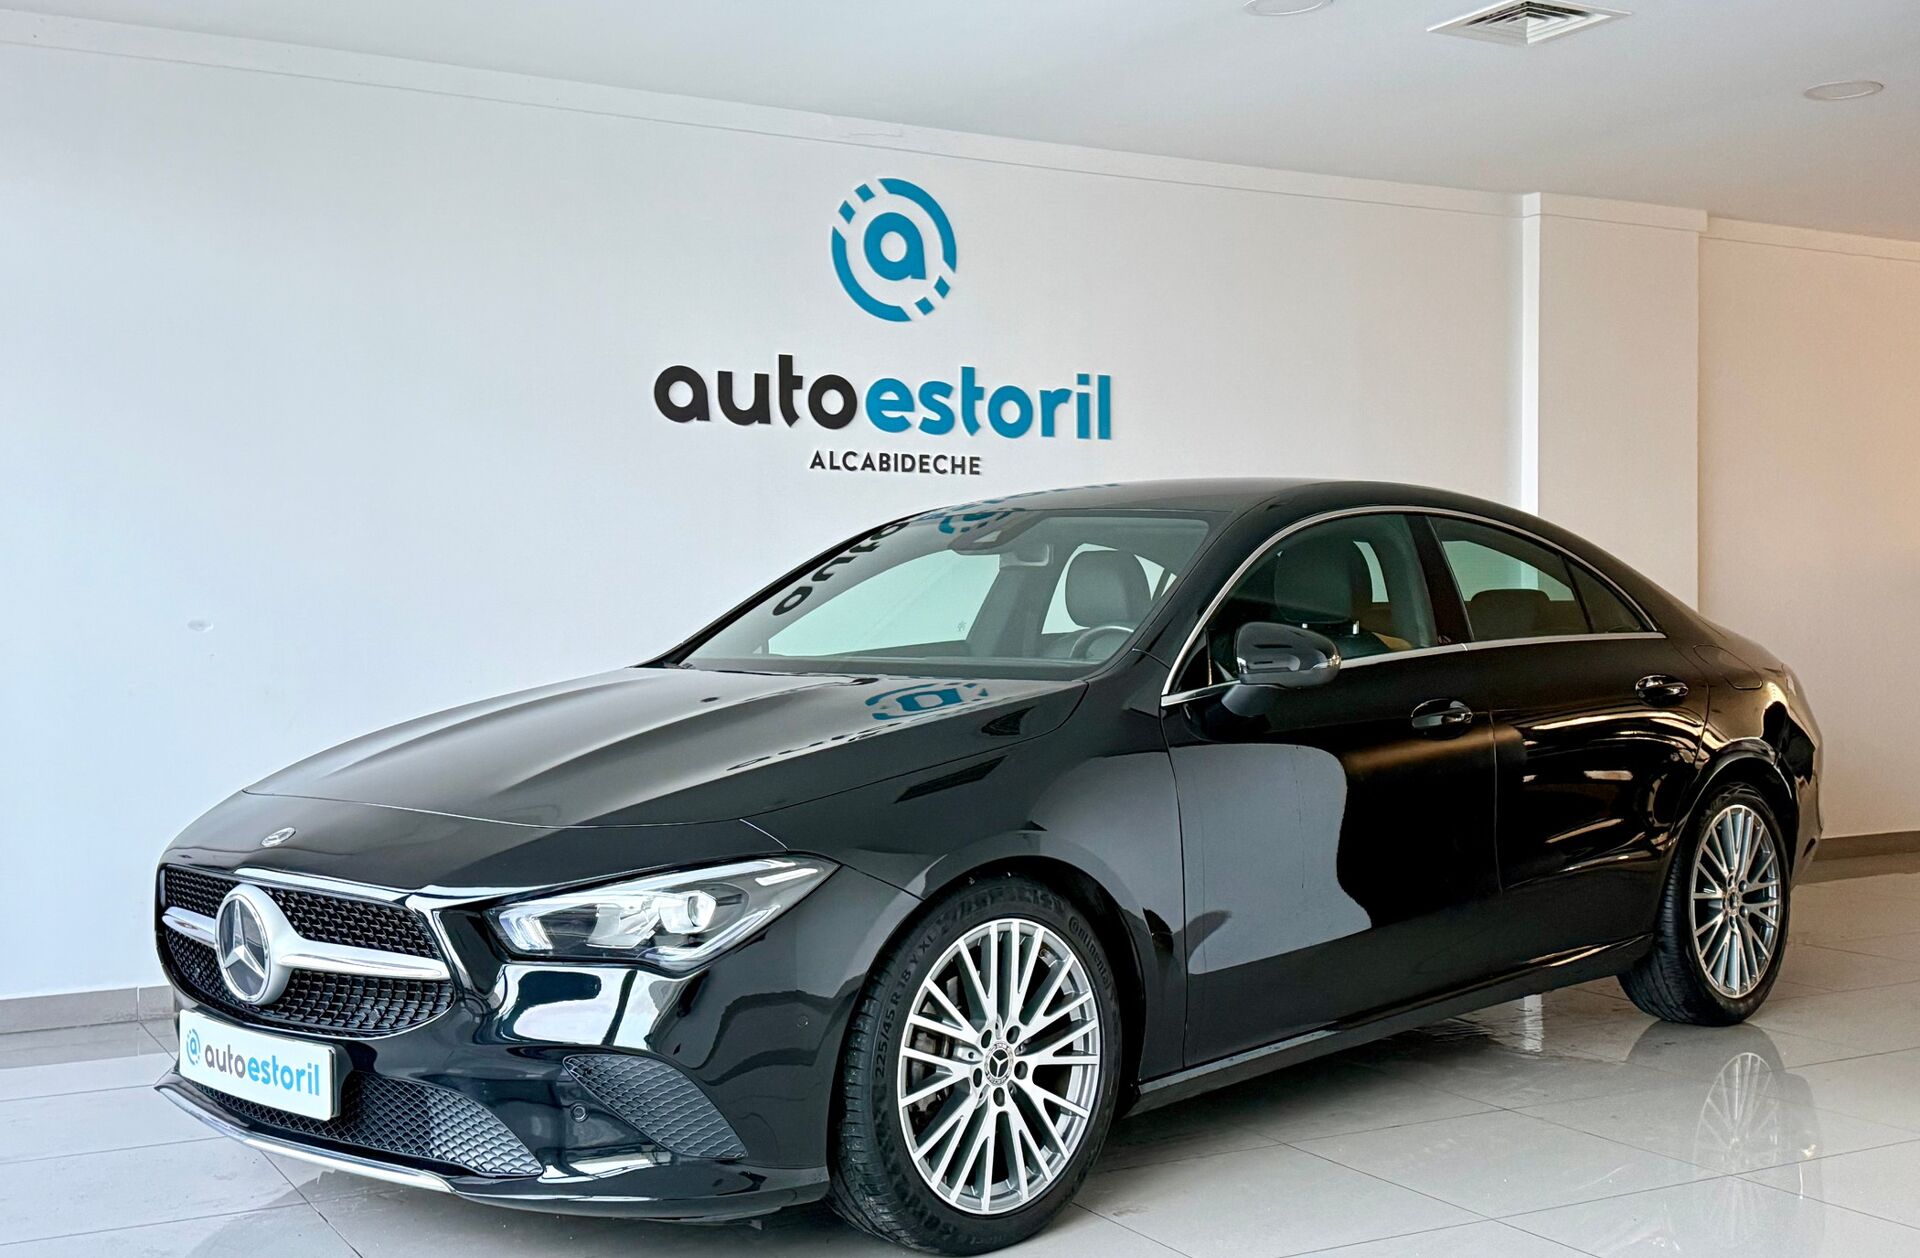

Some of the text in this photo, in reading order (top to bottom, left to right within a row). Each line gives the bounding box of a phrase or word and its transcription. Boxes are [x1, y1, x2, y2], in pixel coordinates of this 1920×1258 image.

[654, 354, 1112, 441] autoestoril
[809, 450, 982, 476] ALCABIDECHE
[205, 1044, 320, 1097] autoestoril
[875, 1008, 897, 1079] 225/45
